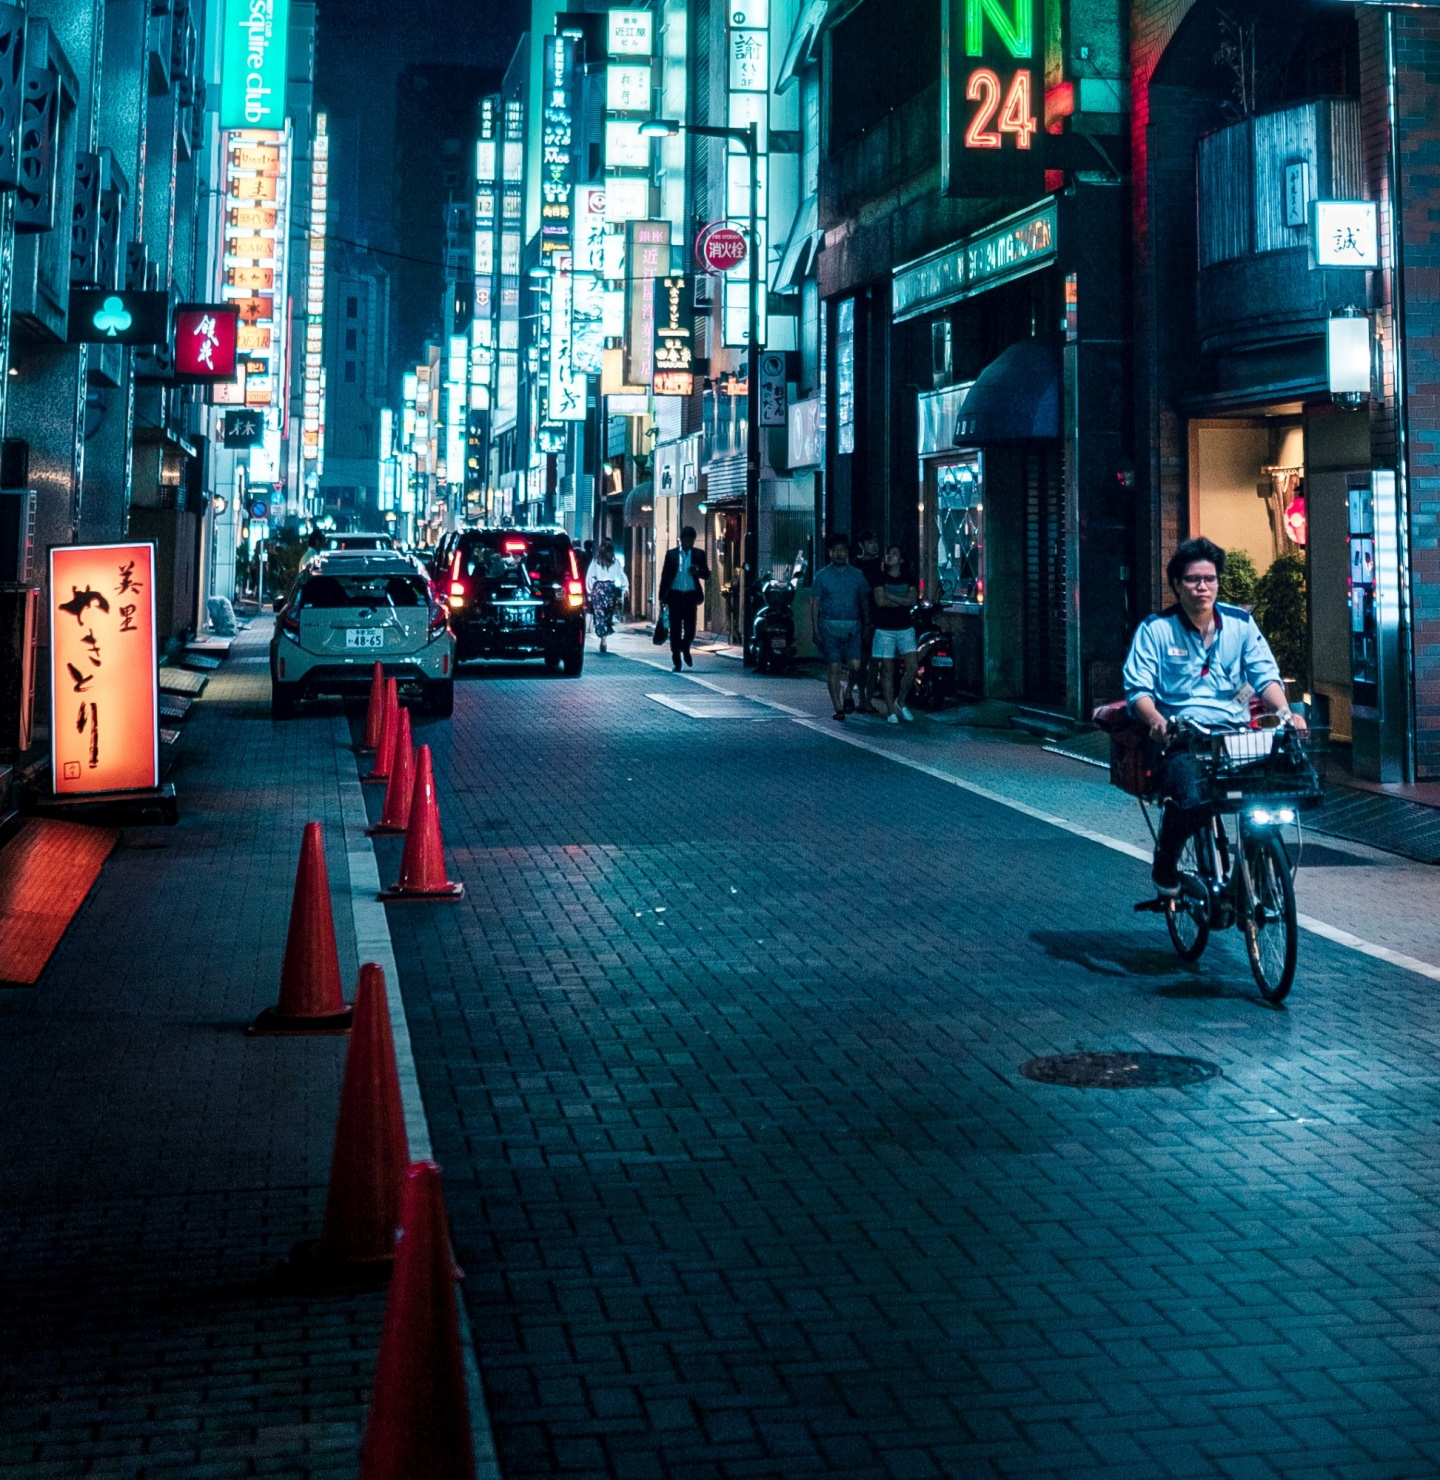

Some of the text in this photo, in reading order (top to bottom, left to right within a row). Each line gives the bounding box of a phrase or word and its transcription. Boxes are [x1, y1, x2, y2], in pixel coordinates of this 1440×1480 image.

[614, 26, 647, 38] 近江屋
[621, 39, 639, 47] ビル
[740, 78, 755, 87] 3F
[244, 73, 272, 123] club
[964, 66, 1037, 150] 24
[639, 229, 664, 243] 銀座
[1332, 226, 1365, 258] 誠
[238, 241, 273, 255] CARA
[709, 241, 745, 259] 消火栓
[113, 560, 144, 632] 美里
[57, 584, 110, 769] やきとり
